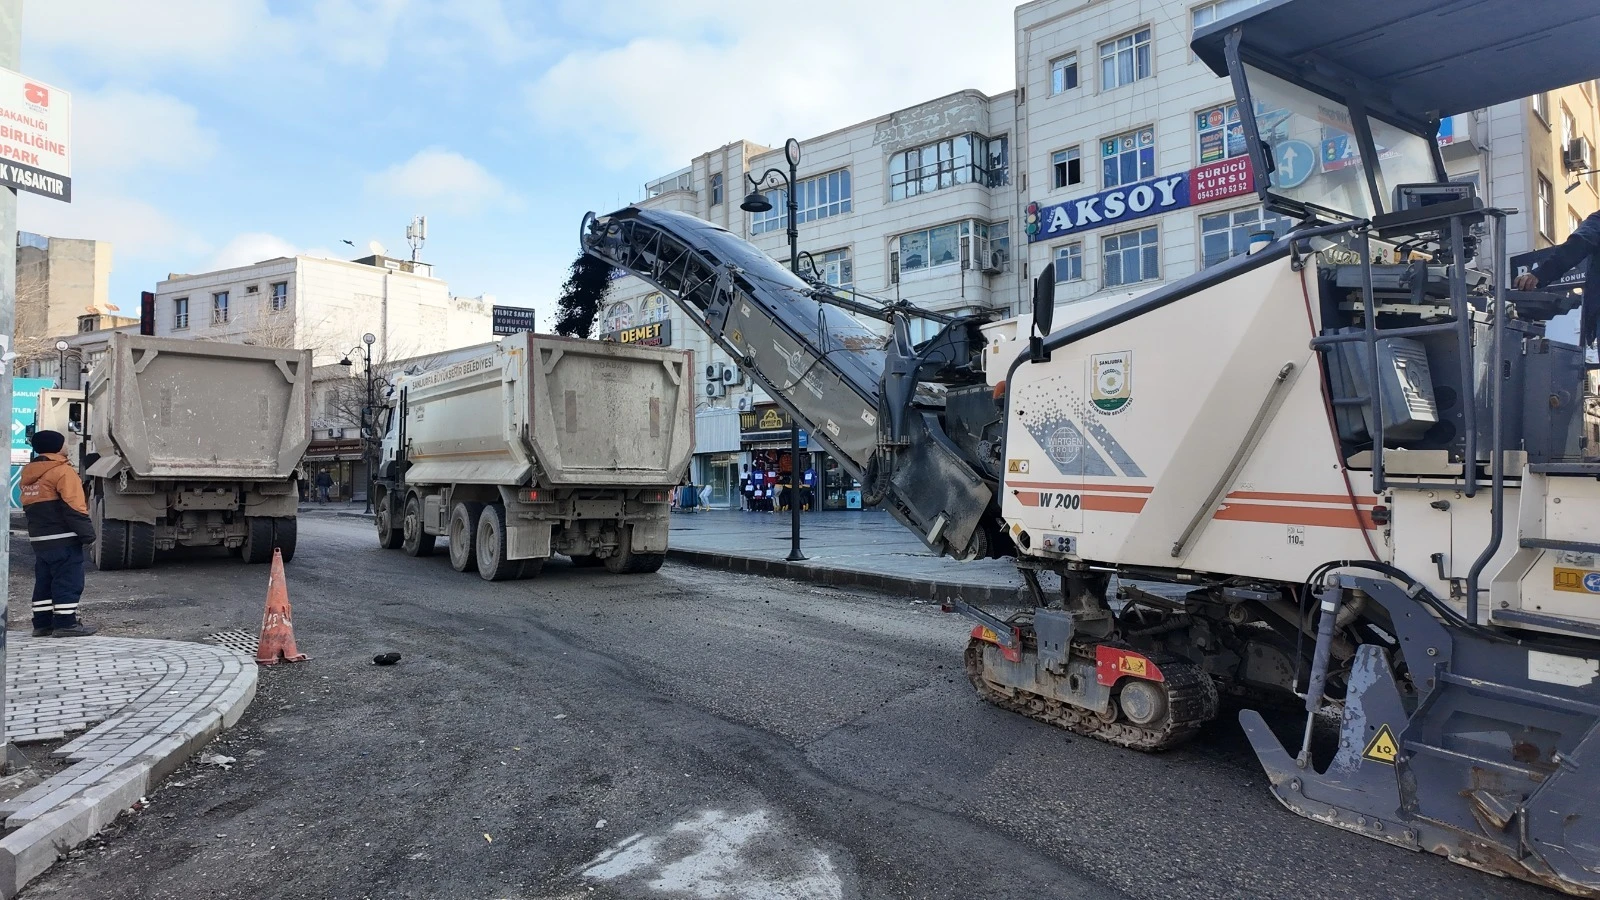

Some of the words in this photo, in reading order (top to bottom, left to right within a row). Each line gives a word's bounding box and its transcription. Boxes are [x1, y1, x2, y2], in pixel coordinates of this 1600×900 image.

[1209, 114, 1222, 122] DUR
[0, 125, 66, 156] BİRLİĞİNE
[1197, 160, 1246, 180] SÜRÜCÜ
[10, 165, 64, 195] YASAKTIR
[1197, 172, 1247, 190] KURSU
[1197, 189, 1214, 200] 0543
[1215, 187, 1228, 196] 370
[1228, 184, 1237, 193] 52
[1238, 182, 1247, 191] 52
[1047, 176, 1182, 233] AKSOY
[1560, 272, 1586, 283] KONUK
[494, 309, 513, 317] YILDIZ
[513, 310, 535, 319] SARAYI
[494, 325, 517, 333] BUTİK
[621, 323, 661, 343] DEMET
[1048, 437, 1083, 446] WIRTGEN
[1040, 492, 1053, 508] W
[1055, 493, 1081, 510] 200
[1288, 535, 1299, 544] 110
